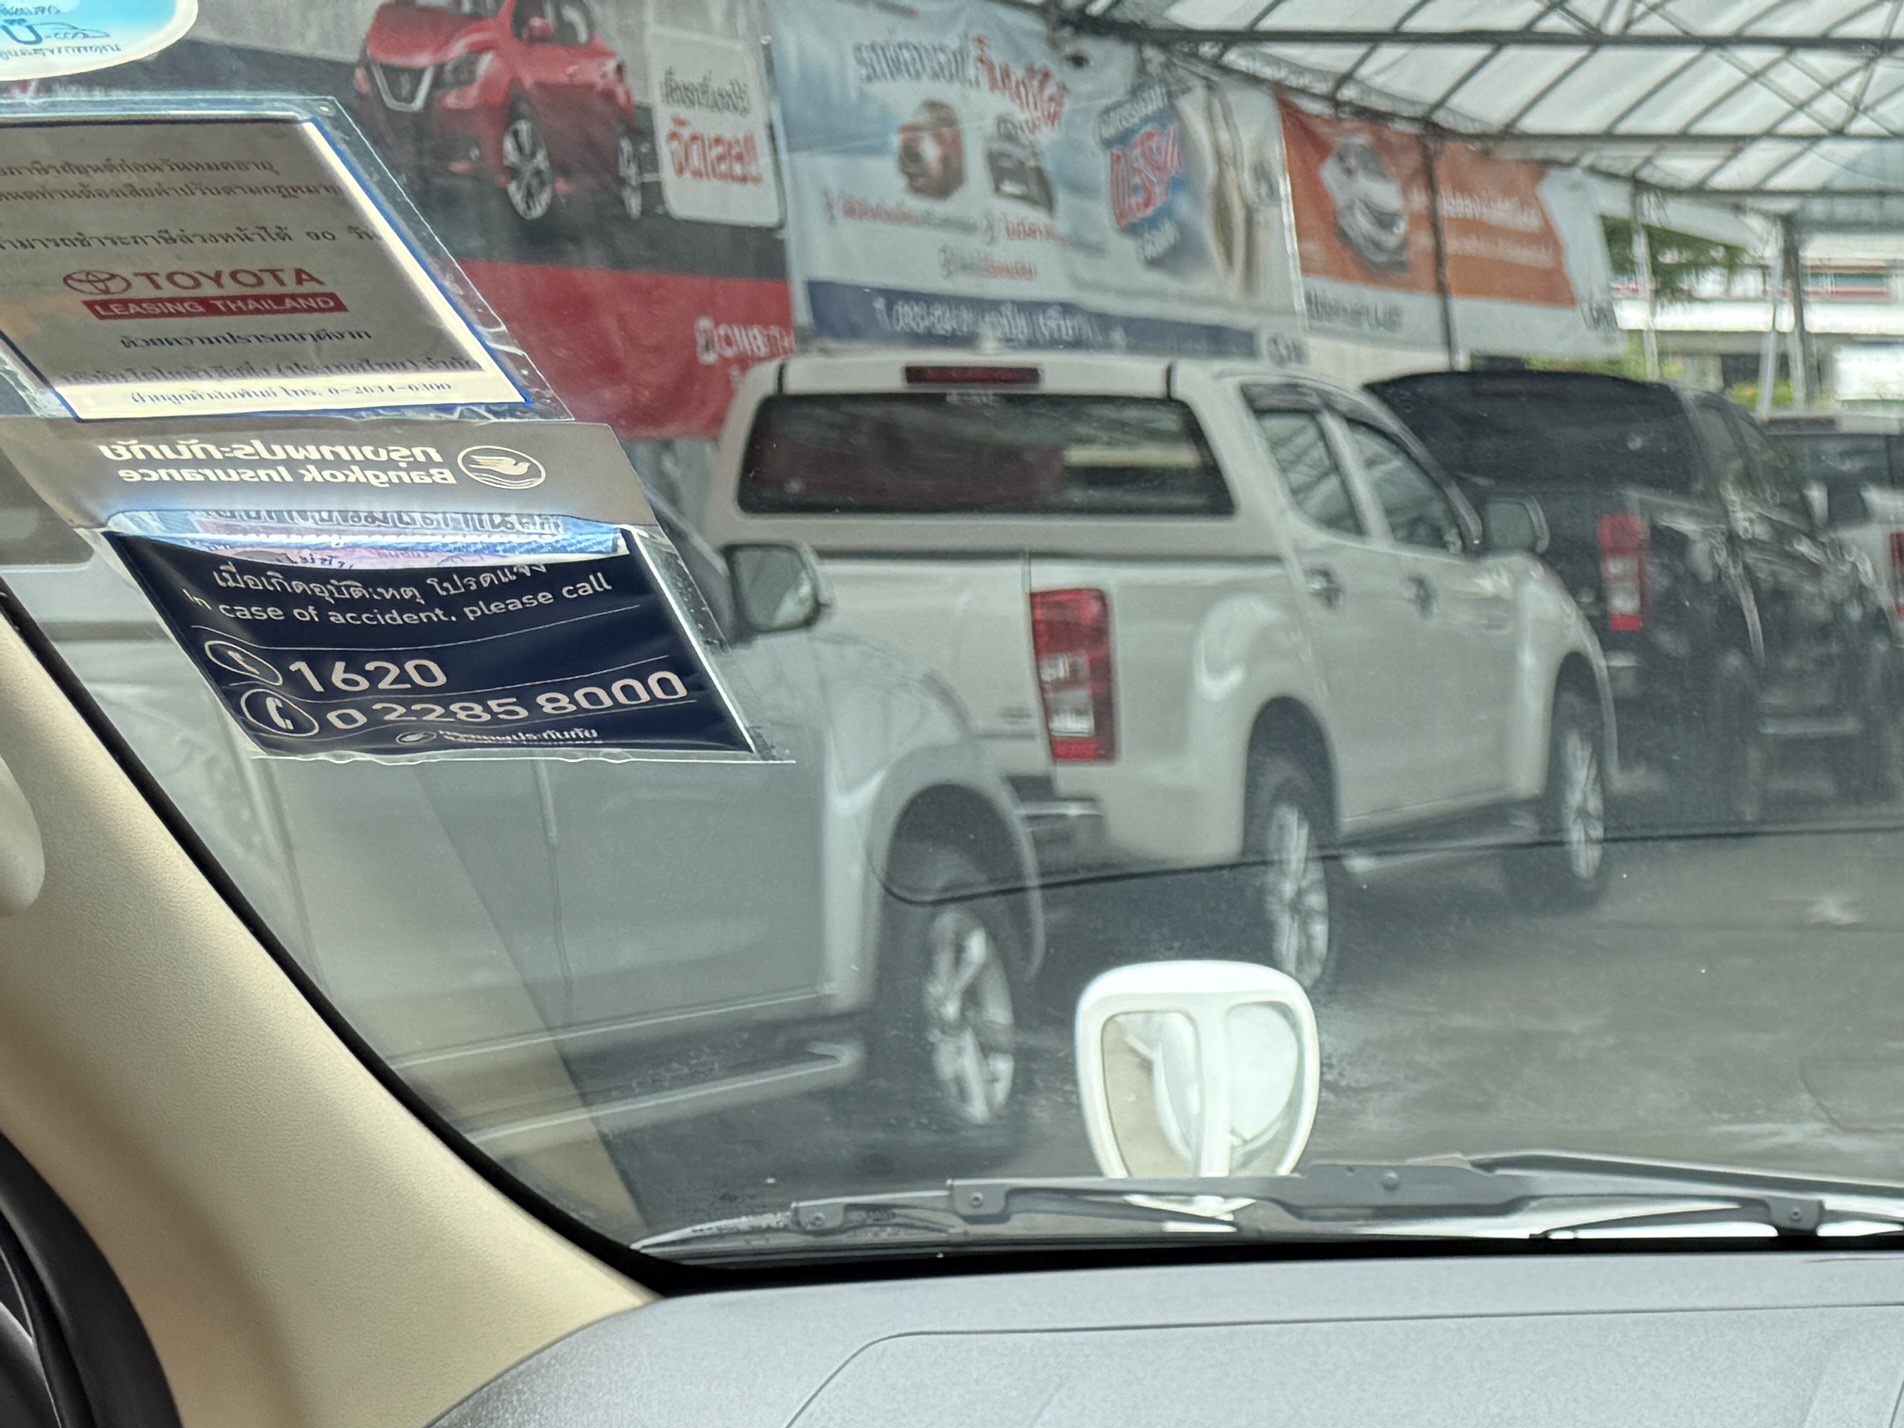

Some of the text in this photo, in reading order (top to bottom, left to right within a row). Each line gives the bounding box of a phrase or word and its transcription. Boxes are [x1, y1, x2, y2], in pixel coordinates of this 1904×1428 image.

[134, 267, 325, 290] TOYOTA
[98, 296, 336, 317] LEASING THAILAND
[218, 603, 286, 621] case
[293, 605, 321, 622] of
[463, 591, 555, 621] please
[561, 571, 612, 600] call
[289, 658, 448, 693] 1620
[326, 670, 688, 730] 0 2285 8000
